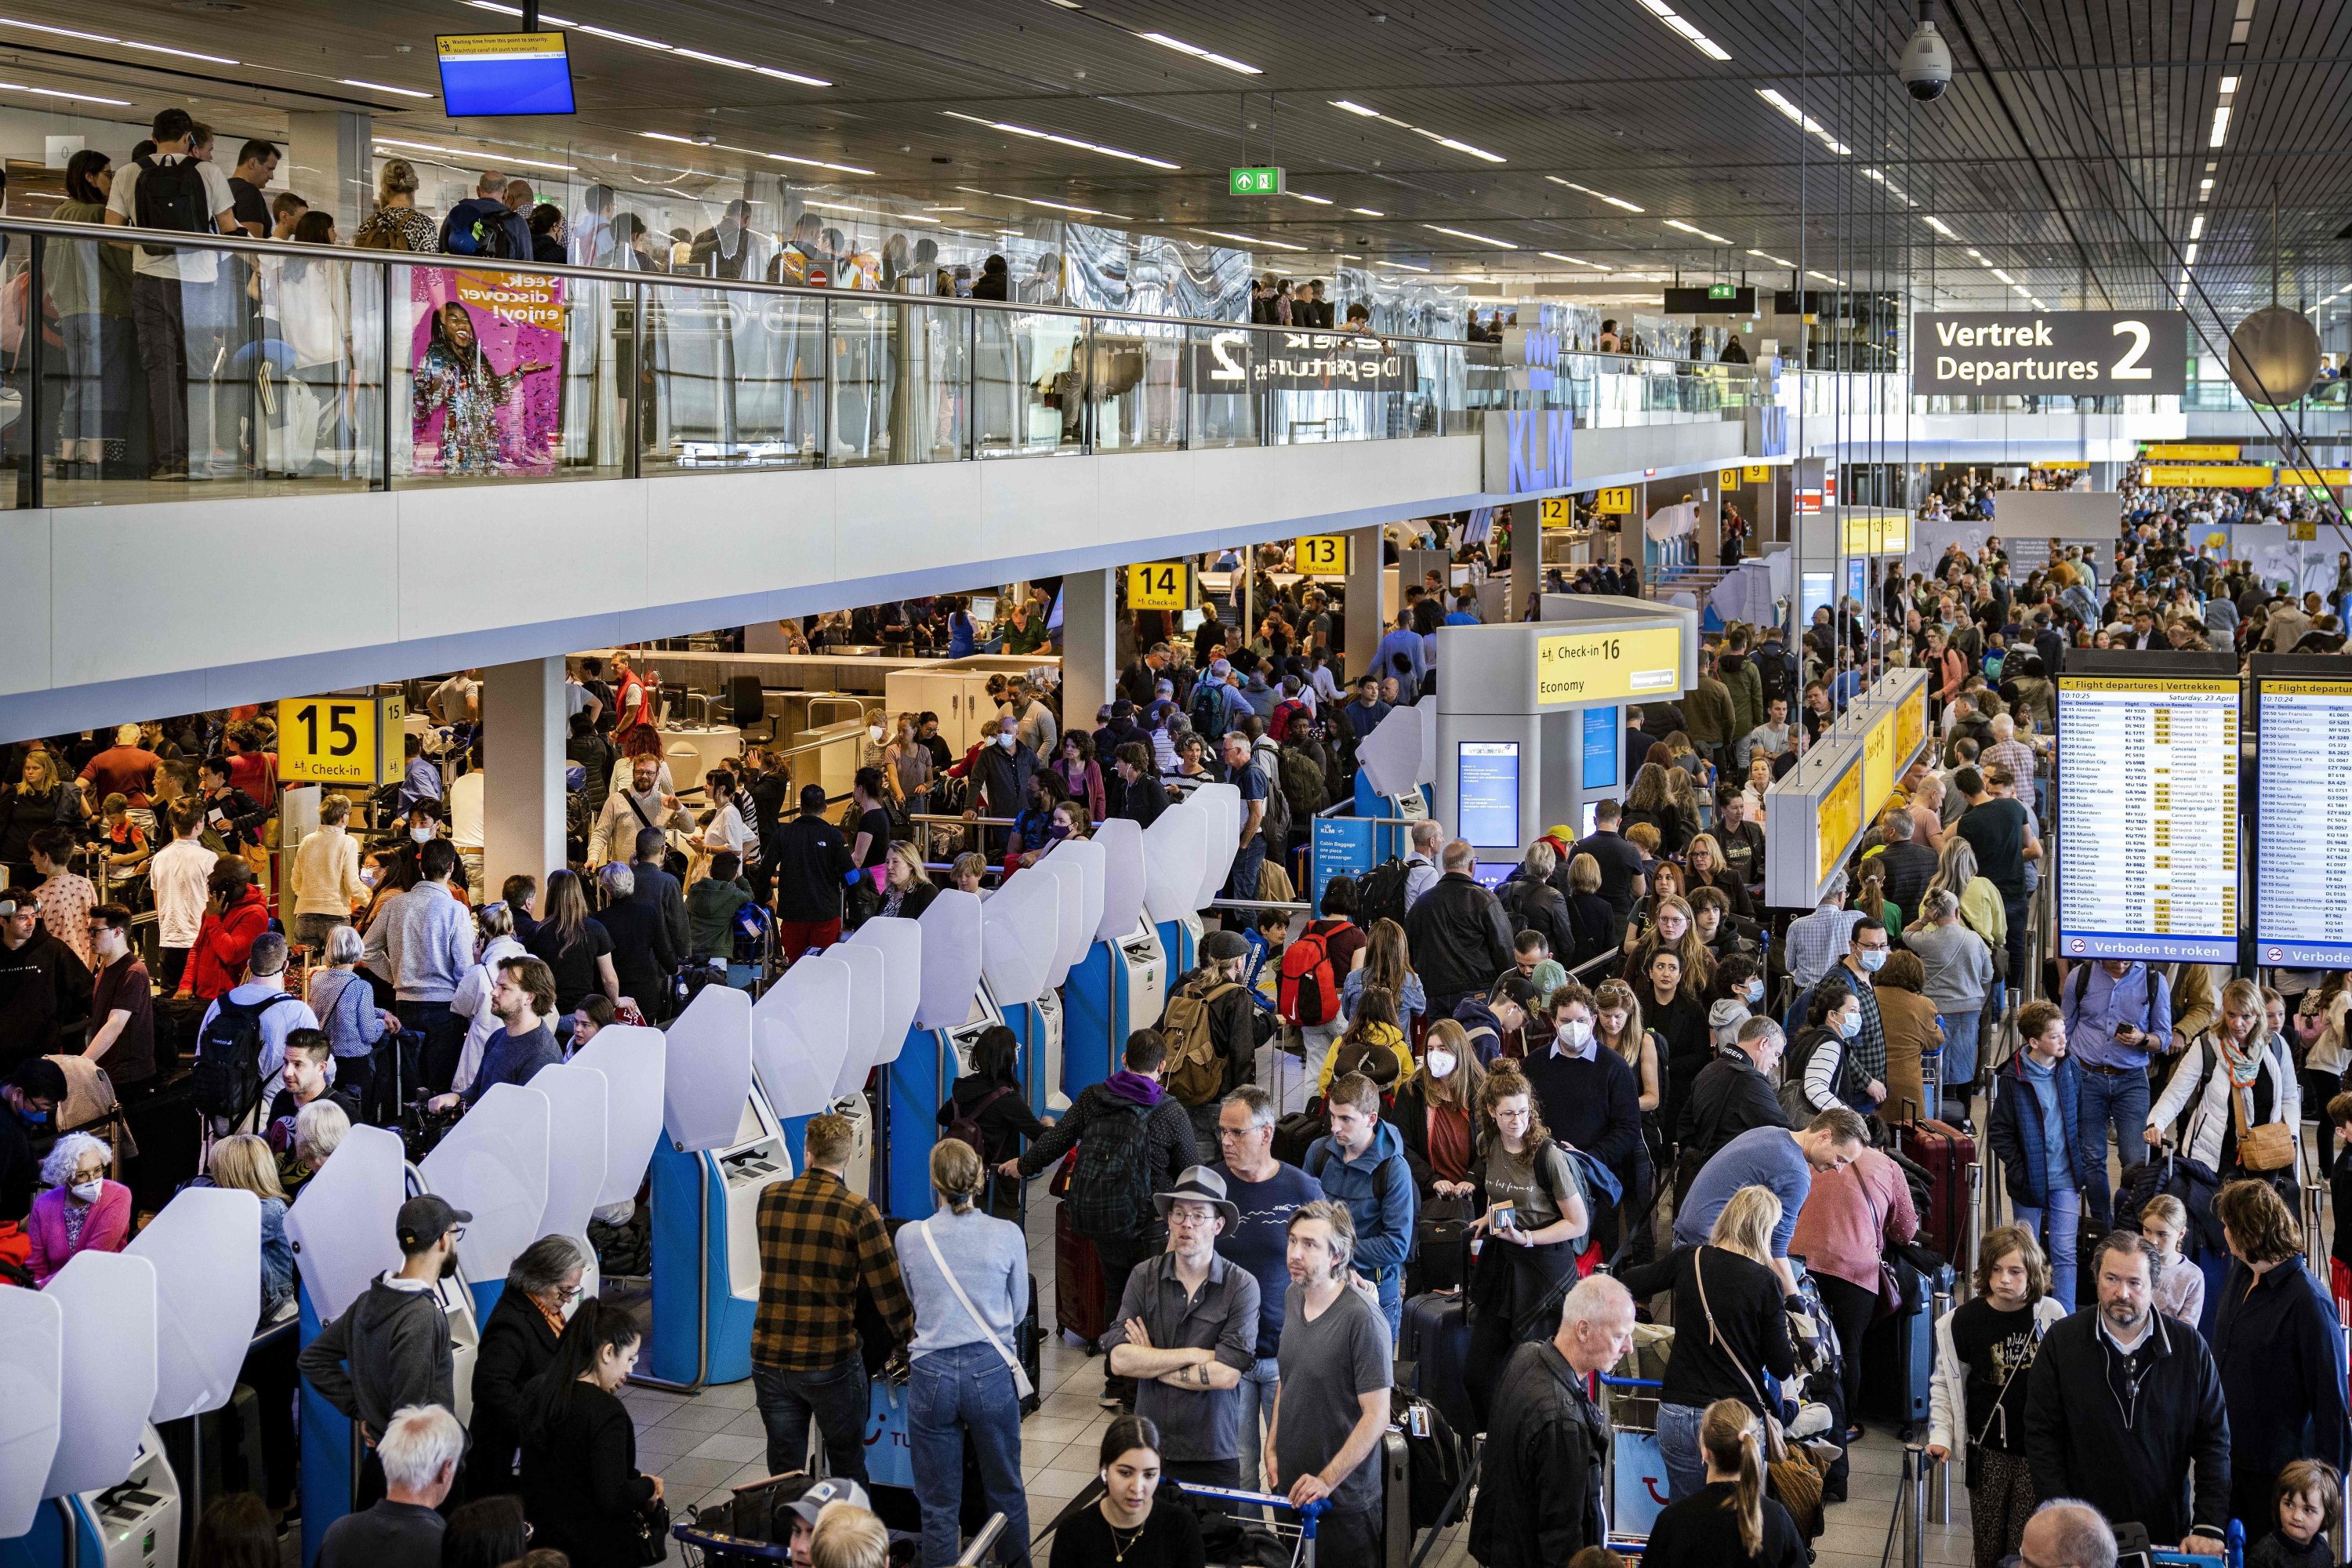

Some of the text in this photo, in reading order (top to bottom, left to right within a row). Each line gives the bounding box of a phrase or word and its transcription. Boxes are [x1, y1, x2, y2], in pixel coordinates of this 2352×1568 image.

[1936, 320, 2152, 379] Vertrek 2
[1936, 356, 2099, 386] Departures
[1762, 406, 1788, 457] KLM
[1508, 410, 1573, 495] KLM
[1605, 490, 1624, 506] 11
[1541, 501, 1562, 517] 12
[1873, 521, 1893, 532] 1215
[1305, 539, 1335, 563] 13
[1139, 567, 1177, 595] 14
[1559, 639, 1620, 660] Check-in 16
[1541, 681, 1584, 694] Economy
[2076, 681, 2220, 692] Flight departures Vertrekken
[2278, 684, 2307, 693] Flight
[388, 705, 399, 720] 15
[296, 705, 358, 757] 15
[311, 764, 361, 776] Check-in
[2095, 942, 2220, 956] Verboden te roken
[2292, 950, 2352, 963] Verbode
[2007, 1332, 2027, 1347] Wild
[2005, 1348, 2029, 1365] Heat
